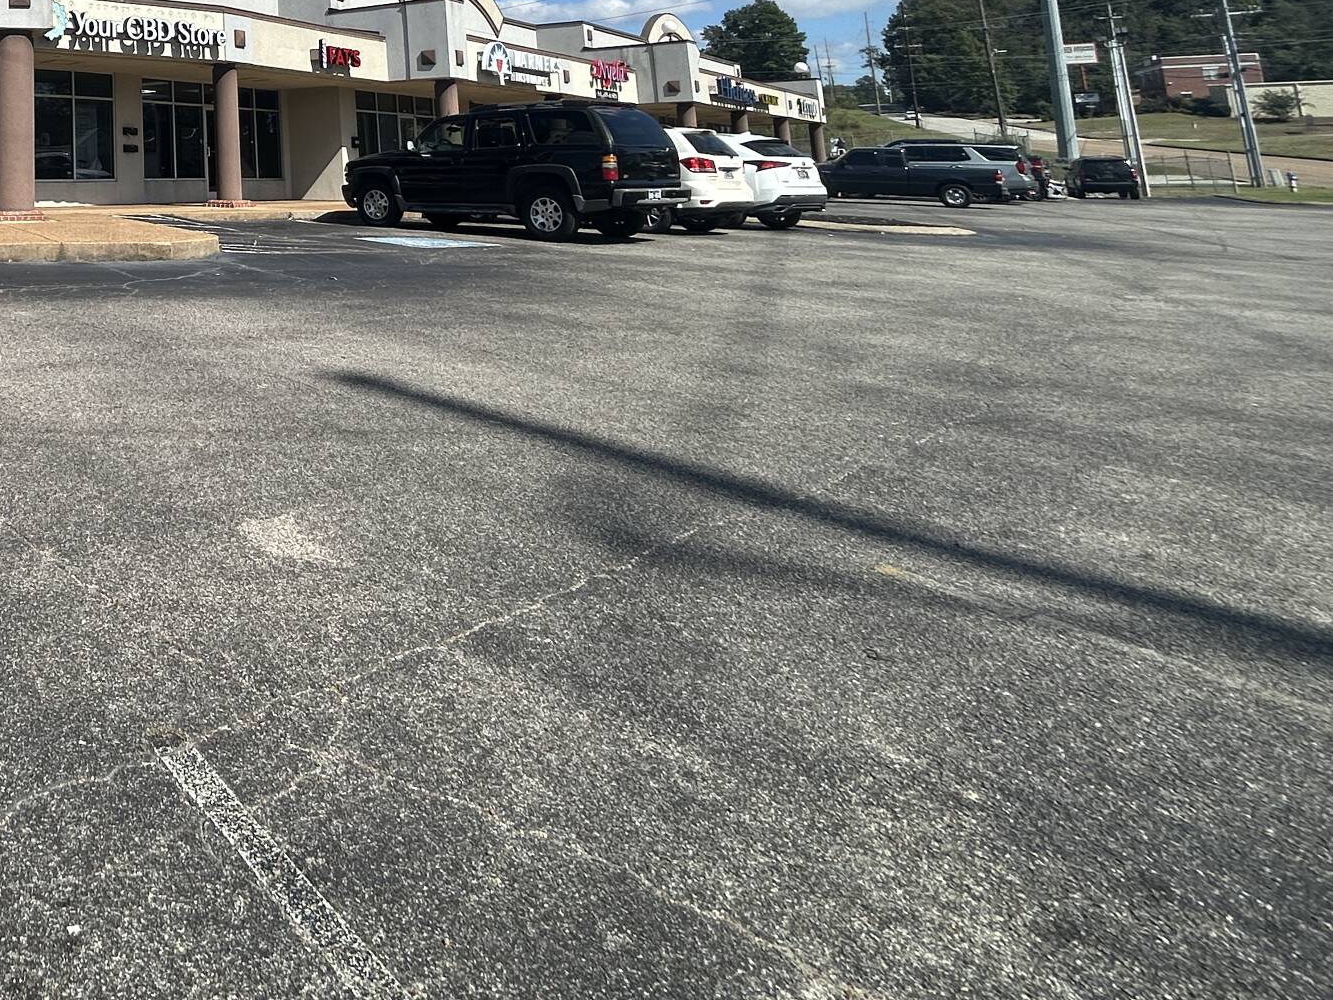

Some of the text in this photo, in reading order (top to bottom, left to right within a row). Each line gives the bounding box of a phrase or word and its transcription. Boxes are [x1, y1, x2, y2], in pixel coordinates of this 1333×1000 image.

[71, 12, 227, 46] Your CBD Store
